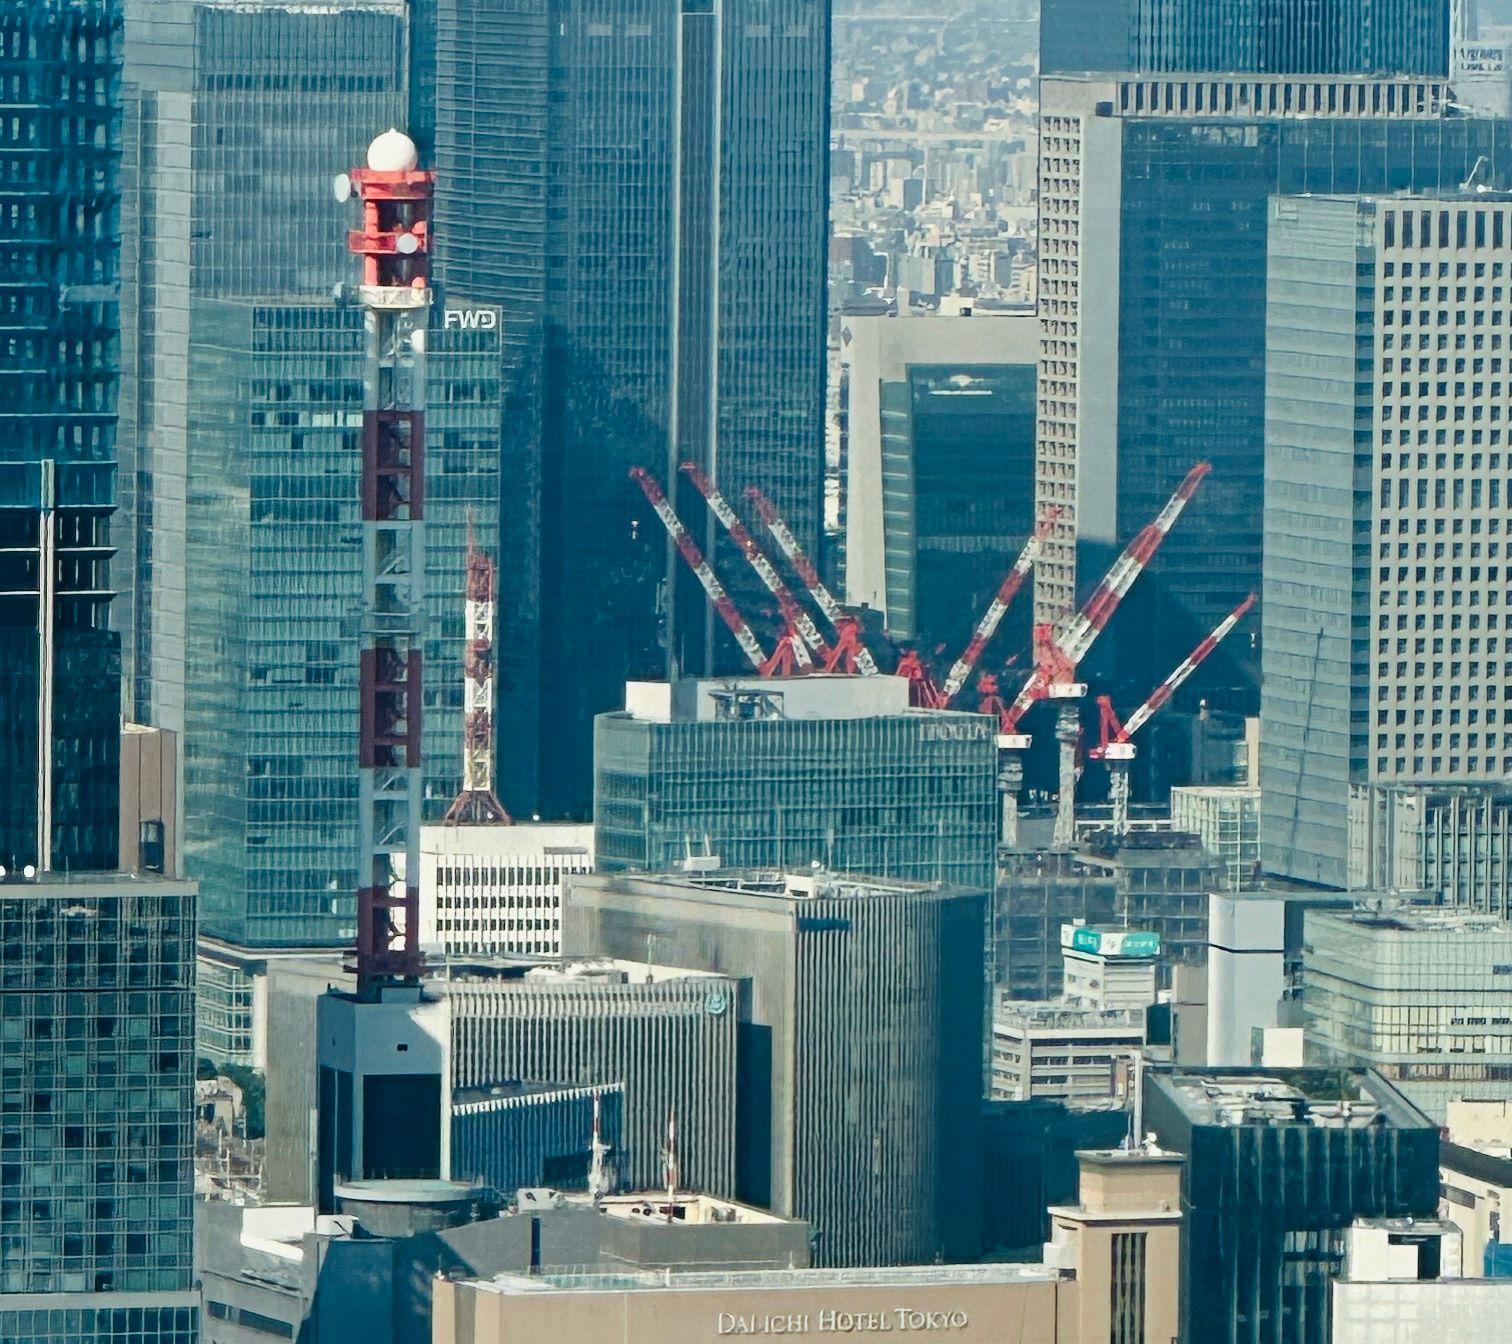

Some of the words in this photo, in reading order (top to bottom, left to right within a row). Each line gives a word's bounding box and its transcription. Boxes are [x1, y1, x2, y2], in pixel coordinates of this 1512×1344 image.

[444, 310, 497, 329] FWD
[819, 1308, 893, 1332] HOTEL
[894, 1307, 969, 1330] TOKYO
